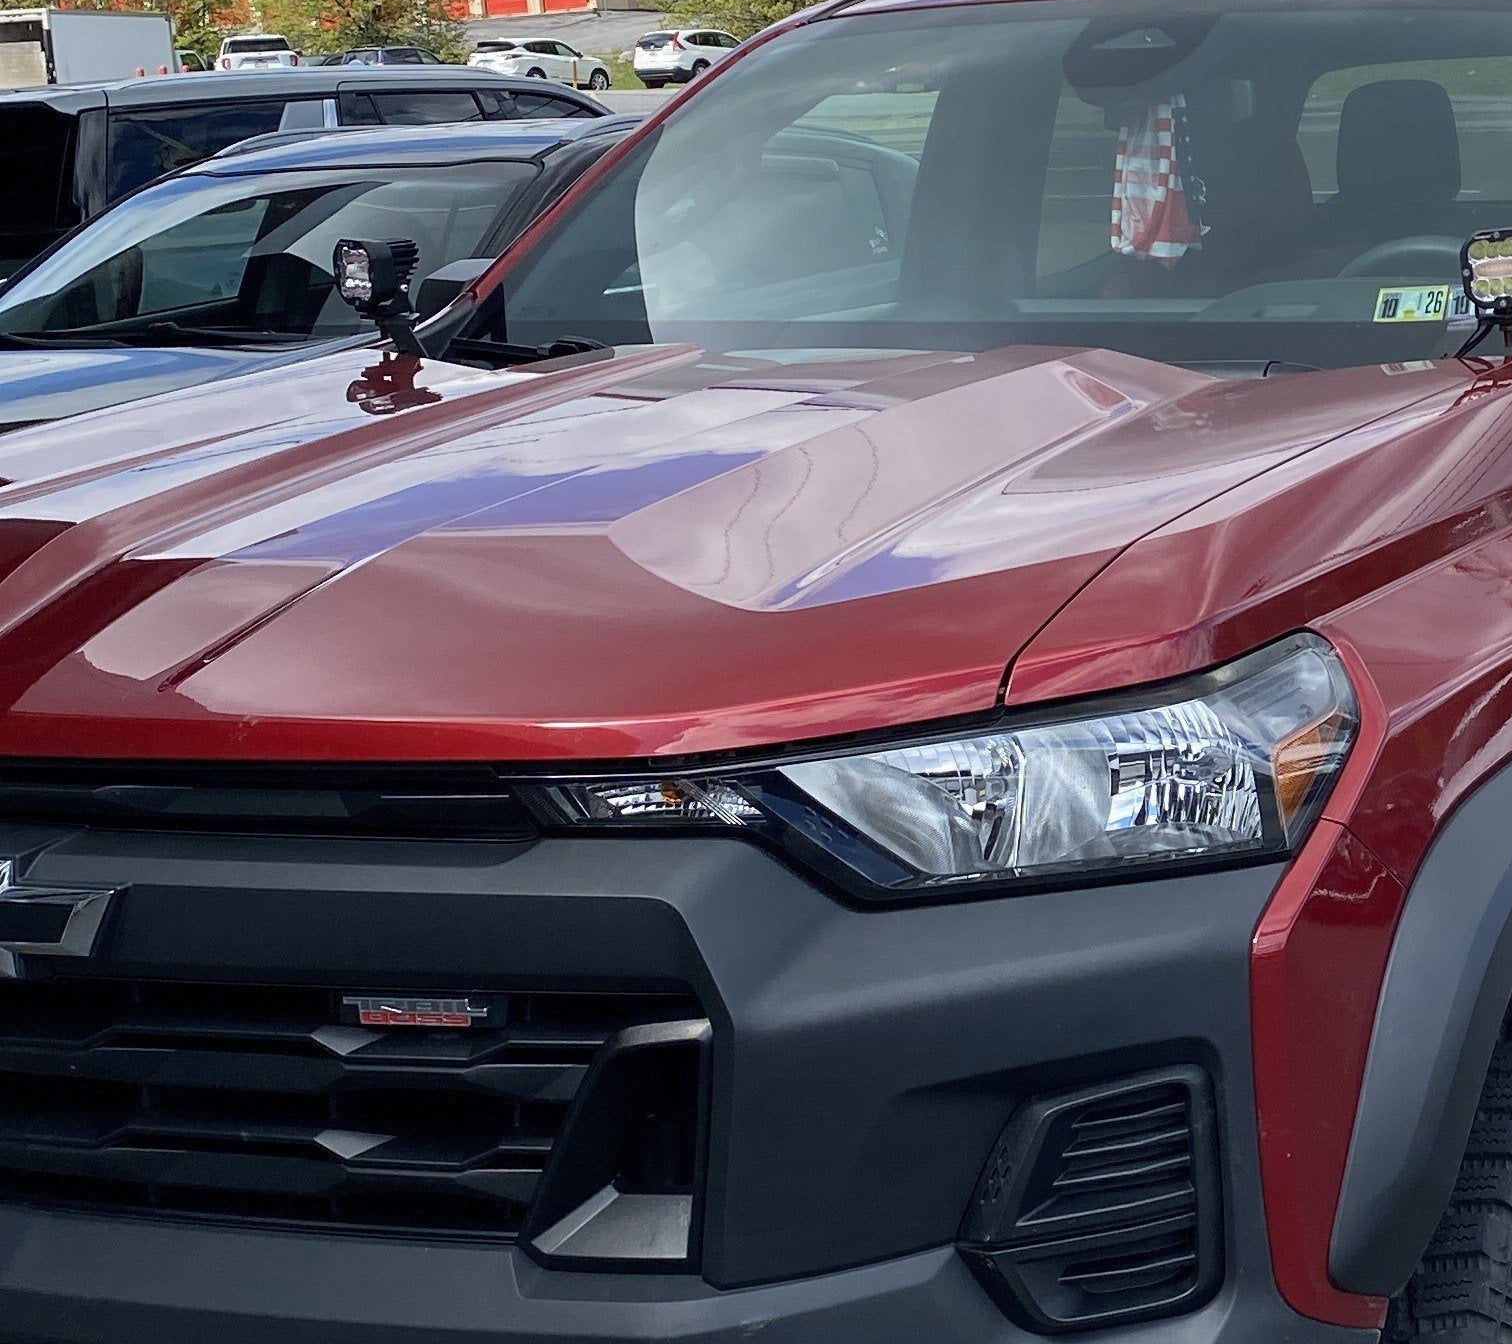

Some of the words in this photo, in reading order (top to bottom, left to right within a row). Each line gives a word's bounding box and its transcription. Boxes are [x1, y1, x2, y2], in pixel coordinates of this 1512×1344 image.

[1424, 290, 1445, 315] 26
[343, 997, 487, 1017] TRAIL
[360, 1012, 471, 1027] BOSS
